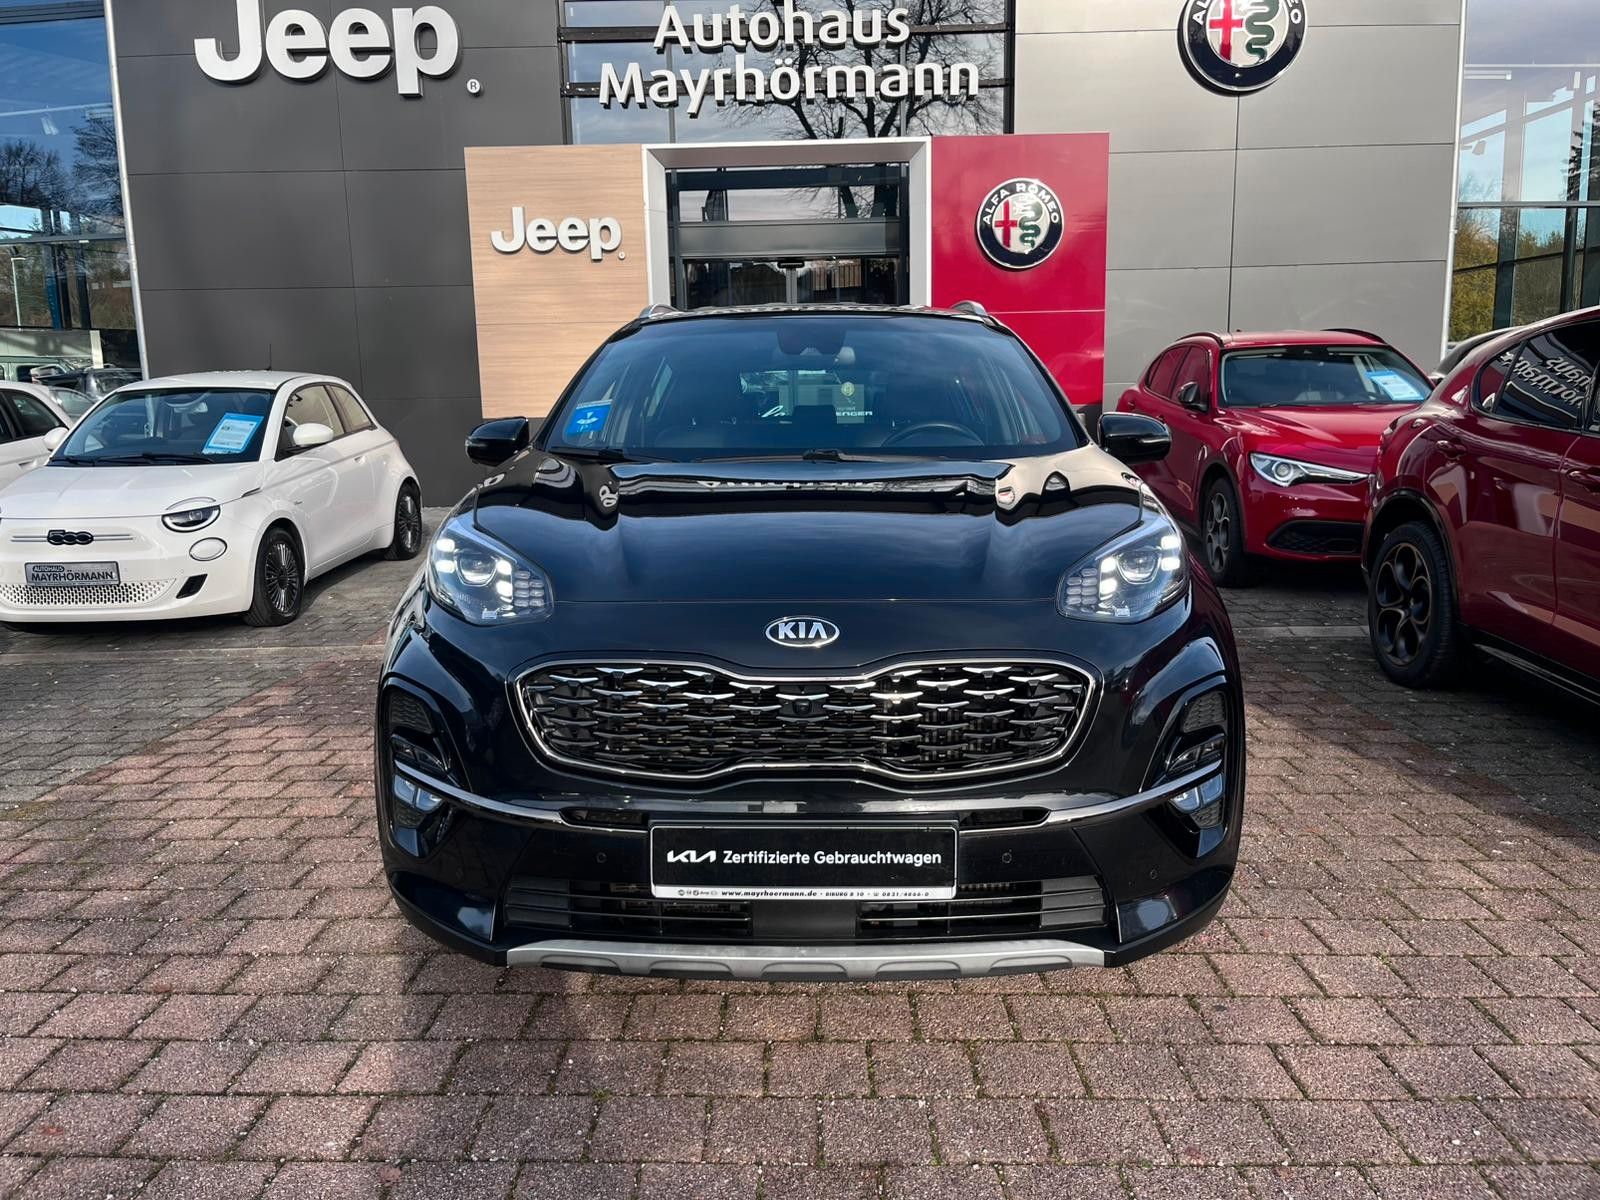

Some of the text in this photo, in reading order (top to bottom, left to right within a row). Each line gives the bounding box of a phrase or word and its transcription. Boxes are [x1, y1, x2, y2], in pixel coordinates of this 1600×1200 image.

[653, 0, 912, 51] Autohaus
[194, 0, 461, 96] Jeep
[599, 53, 980, 117] Mayrhörmann
[982, 182, 1060, 225] ALFA ROMEO
[490, 206, 622, 262] Jeep
[47, 529, 94, 546] 500
[31, 569, 114, 581] MAYRHÖRMANN
[778, 621, 828, 640] KIA
[723, 850, 811, 865] Zertifizierte
[813, 850, 942, 868] Gebrauchtwagen
[721, 889, 817, 898] www.mayrhoermann.de
